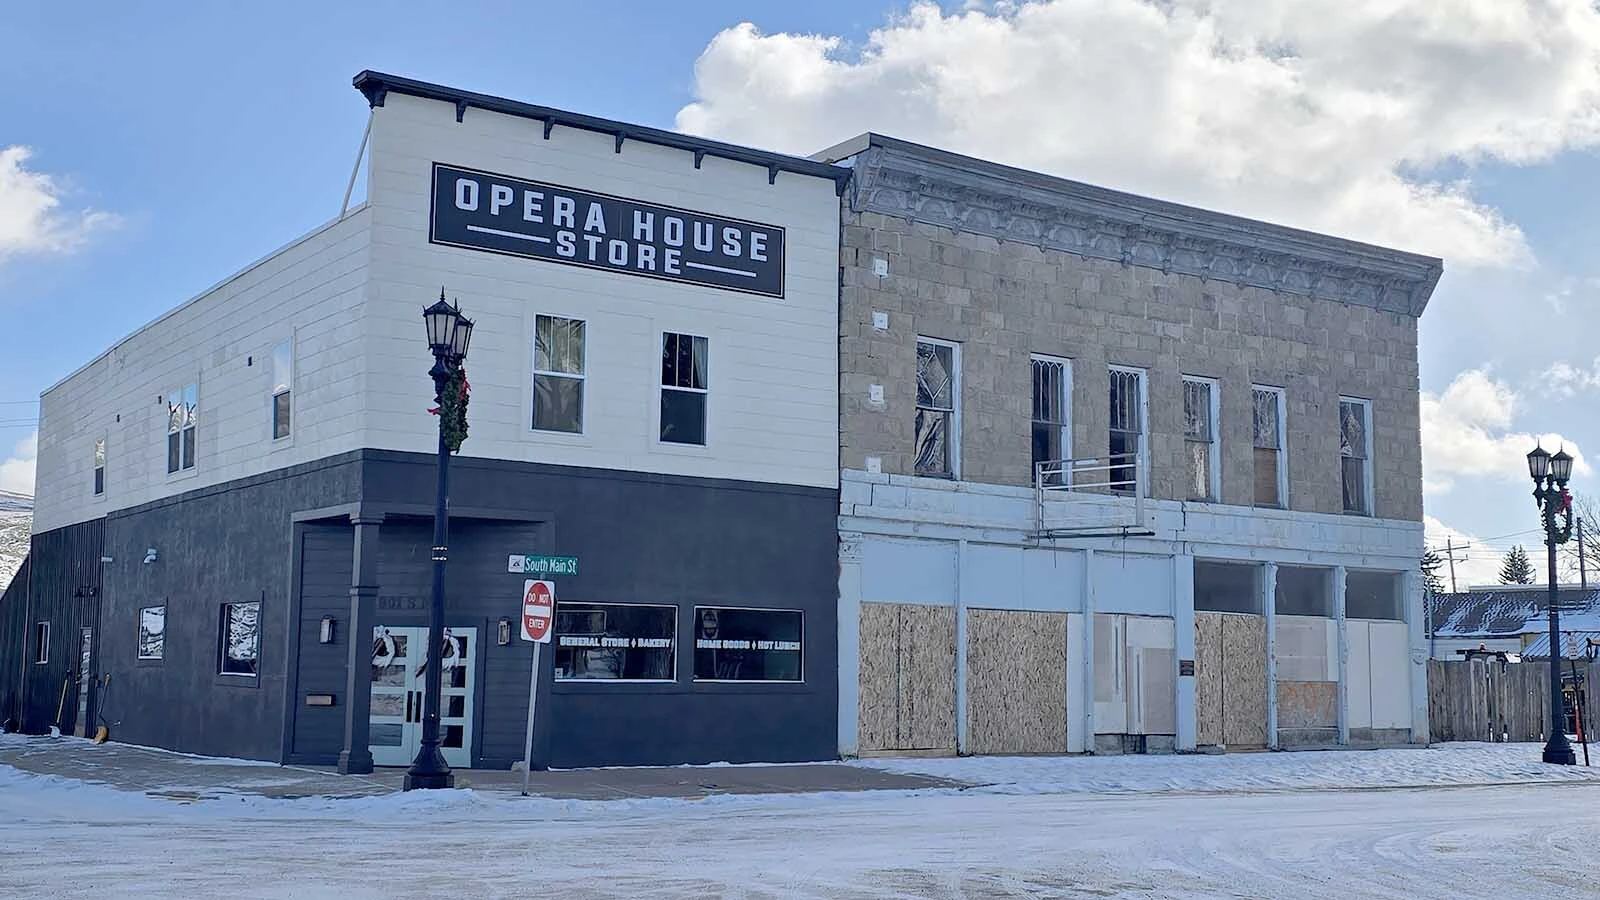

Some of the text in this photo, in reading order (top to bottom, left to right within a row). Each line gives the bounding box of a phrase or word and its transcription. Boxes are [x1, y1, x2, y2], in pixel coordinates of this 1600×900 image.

[454, 178, 769, 262] OPERA HOUSE
[556, 230, 682, 275] STORE
[525, 557, 577, 574] South Main St
[528, 592, 550, 604] DO NOT
[528, 618, 545, 629] ENTER
[559, 636, 671, 648] GENERAL STORE BAKERY
[696, 639, 800, 651] HOME GOODS HOT LUNCH
